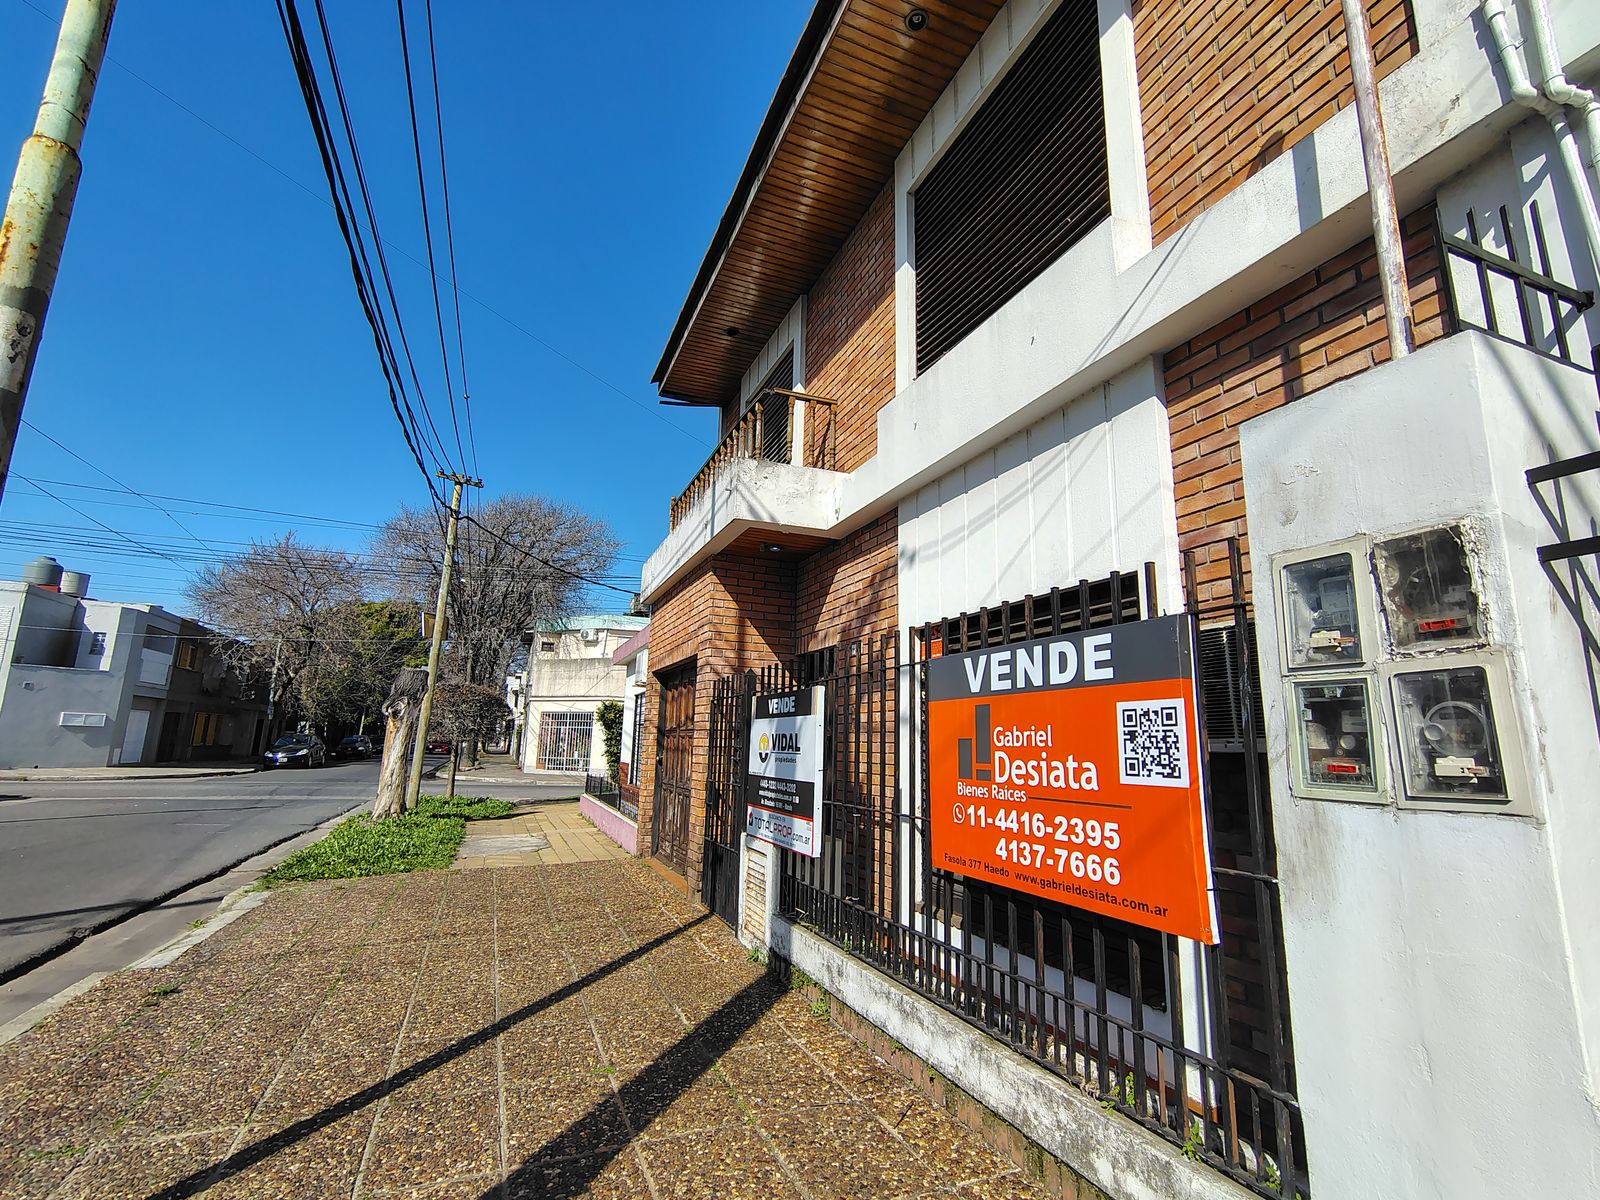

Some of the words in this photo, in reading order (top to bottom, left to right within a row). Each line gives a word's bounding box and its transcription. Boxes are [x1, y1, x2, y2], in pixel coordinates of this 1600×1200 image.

[963, 632, 1115, 694] VENDE
[768, 696, 796, 714] VENDE
[771, 733, 801, 752] VIDAL
[992, 725, 1053, 748] Gabriel
[774, 756, 797, 764] propiedades
[993, 751, 1099, 792] Desiata
[956, 782, 989, 799] Bienes
[991, 784, 1027, 803] Raíces
[754, 816, 810, 845] TOTALPROP.com.ar
[966, 804, 1121, 851] 11-4416-2395
[995, 838, 1121, 886] 4137-7666
[943, 853, 967, 867] Fasola
[968, 857, 982, 870] 377
[983, 862, 1010, 878] Haedo
[1014, 870, 1169, 918] www.gabrieldesiata.com.ar
